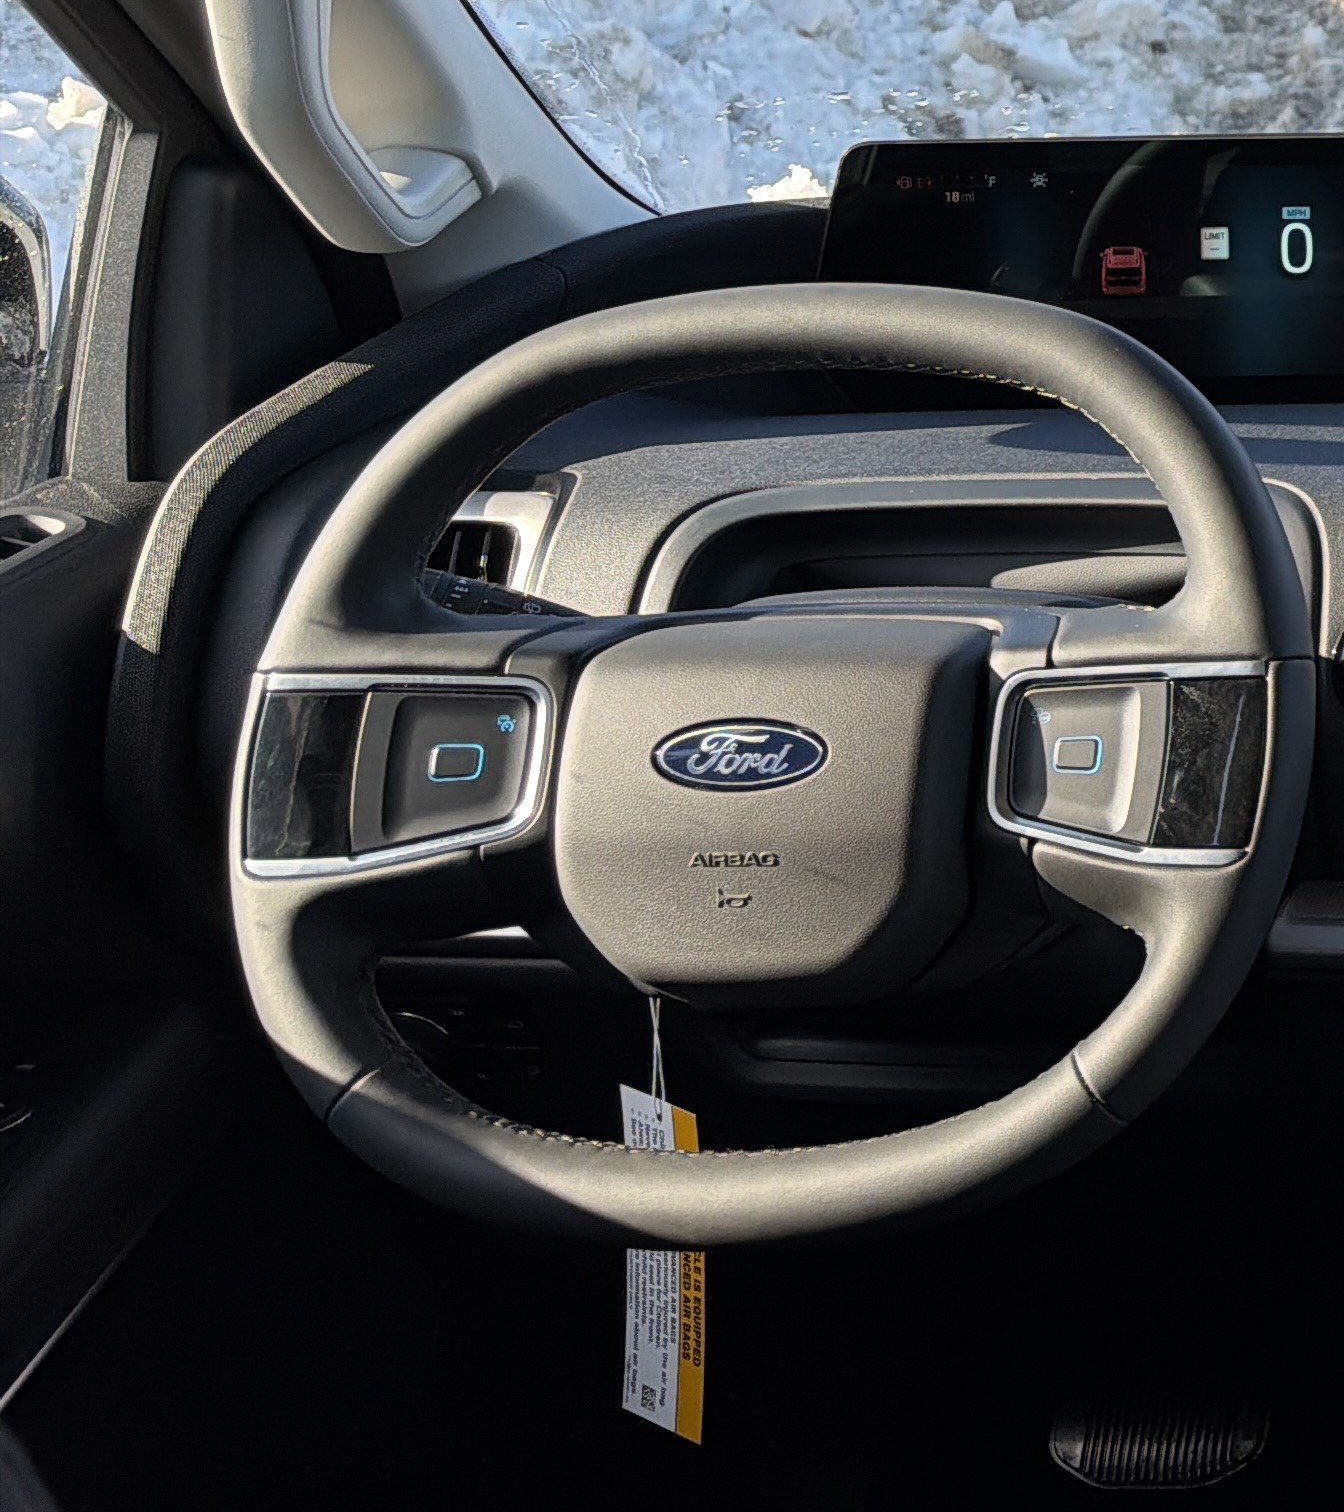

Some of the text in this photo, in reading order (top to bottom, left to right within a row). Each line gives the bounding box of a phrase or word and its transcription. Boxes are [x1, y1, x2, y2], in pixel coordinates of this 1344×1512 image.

[1286, 209, 1307, 217] MPH
[1204, 231, 1225, 240] LIMIT
[1280, 222, 1314, 274] 0
[686, 733, 794, 776] Ford
[689, 851, 781, 868] AIRBAG
[693, 1279, 702, 1291] IS
[682, 1295, 692, 1319] AIR
[681, 1322, 692, 1362] BAGS
[692, 1296, 702, 1368] EQUIPPED
